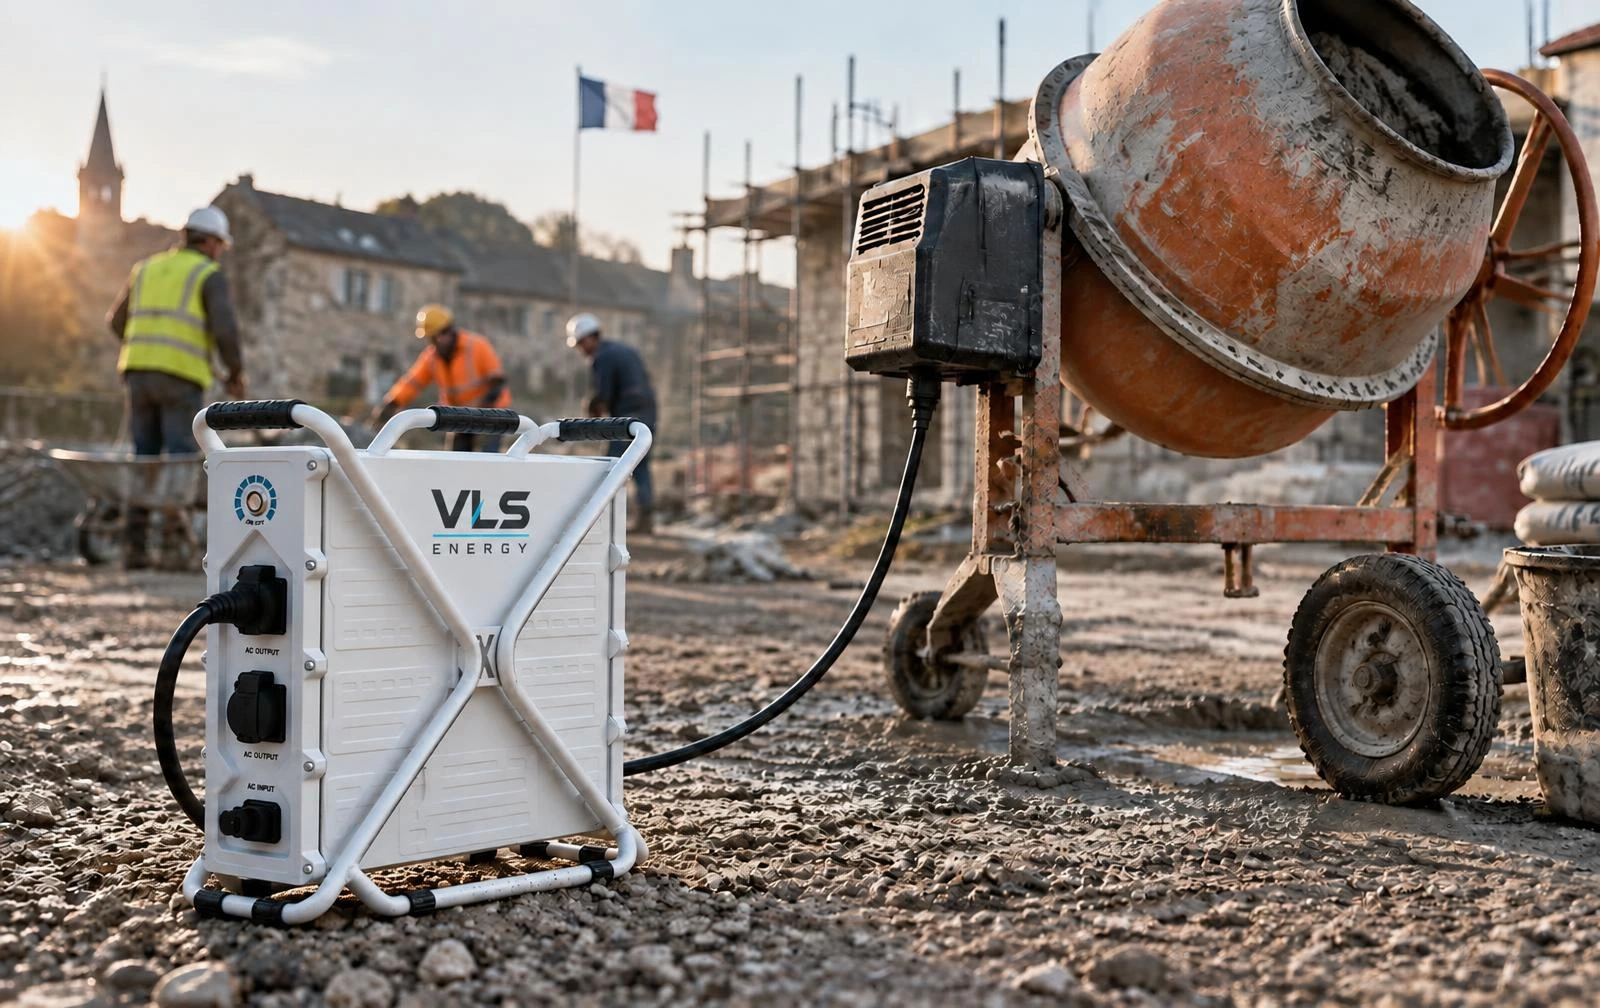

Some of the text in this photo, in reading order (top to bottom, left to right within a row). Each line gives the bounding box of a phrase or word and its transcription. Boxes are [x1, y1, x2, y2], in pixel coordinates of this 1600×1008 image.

[431, 489, 531, 529] VLS
[432, 543, 527, 555] ENERGY
[245, 646, 280, 656] AC OUTPUT
[243, 750, 279, 760] AC OUTPUT
[247, 782, 275, 792] AC INPUT
